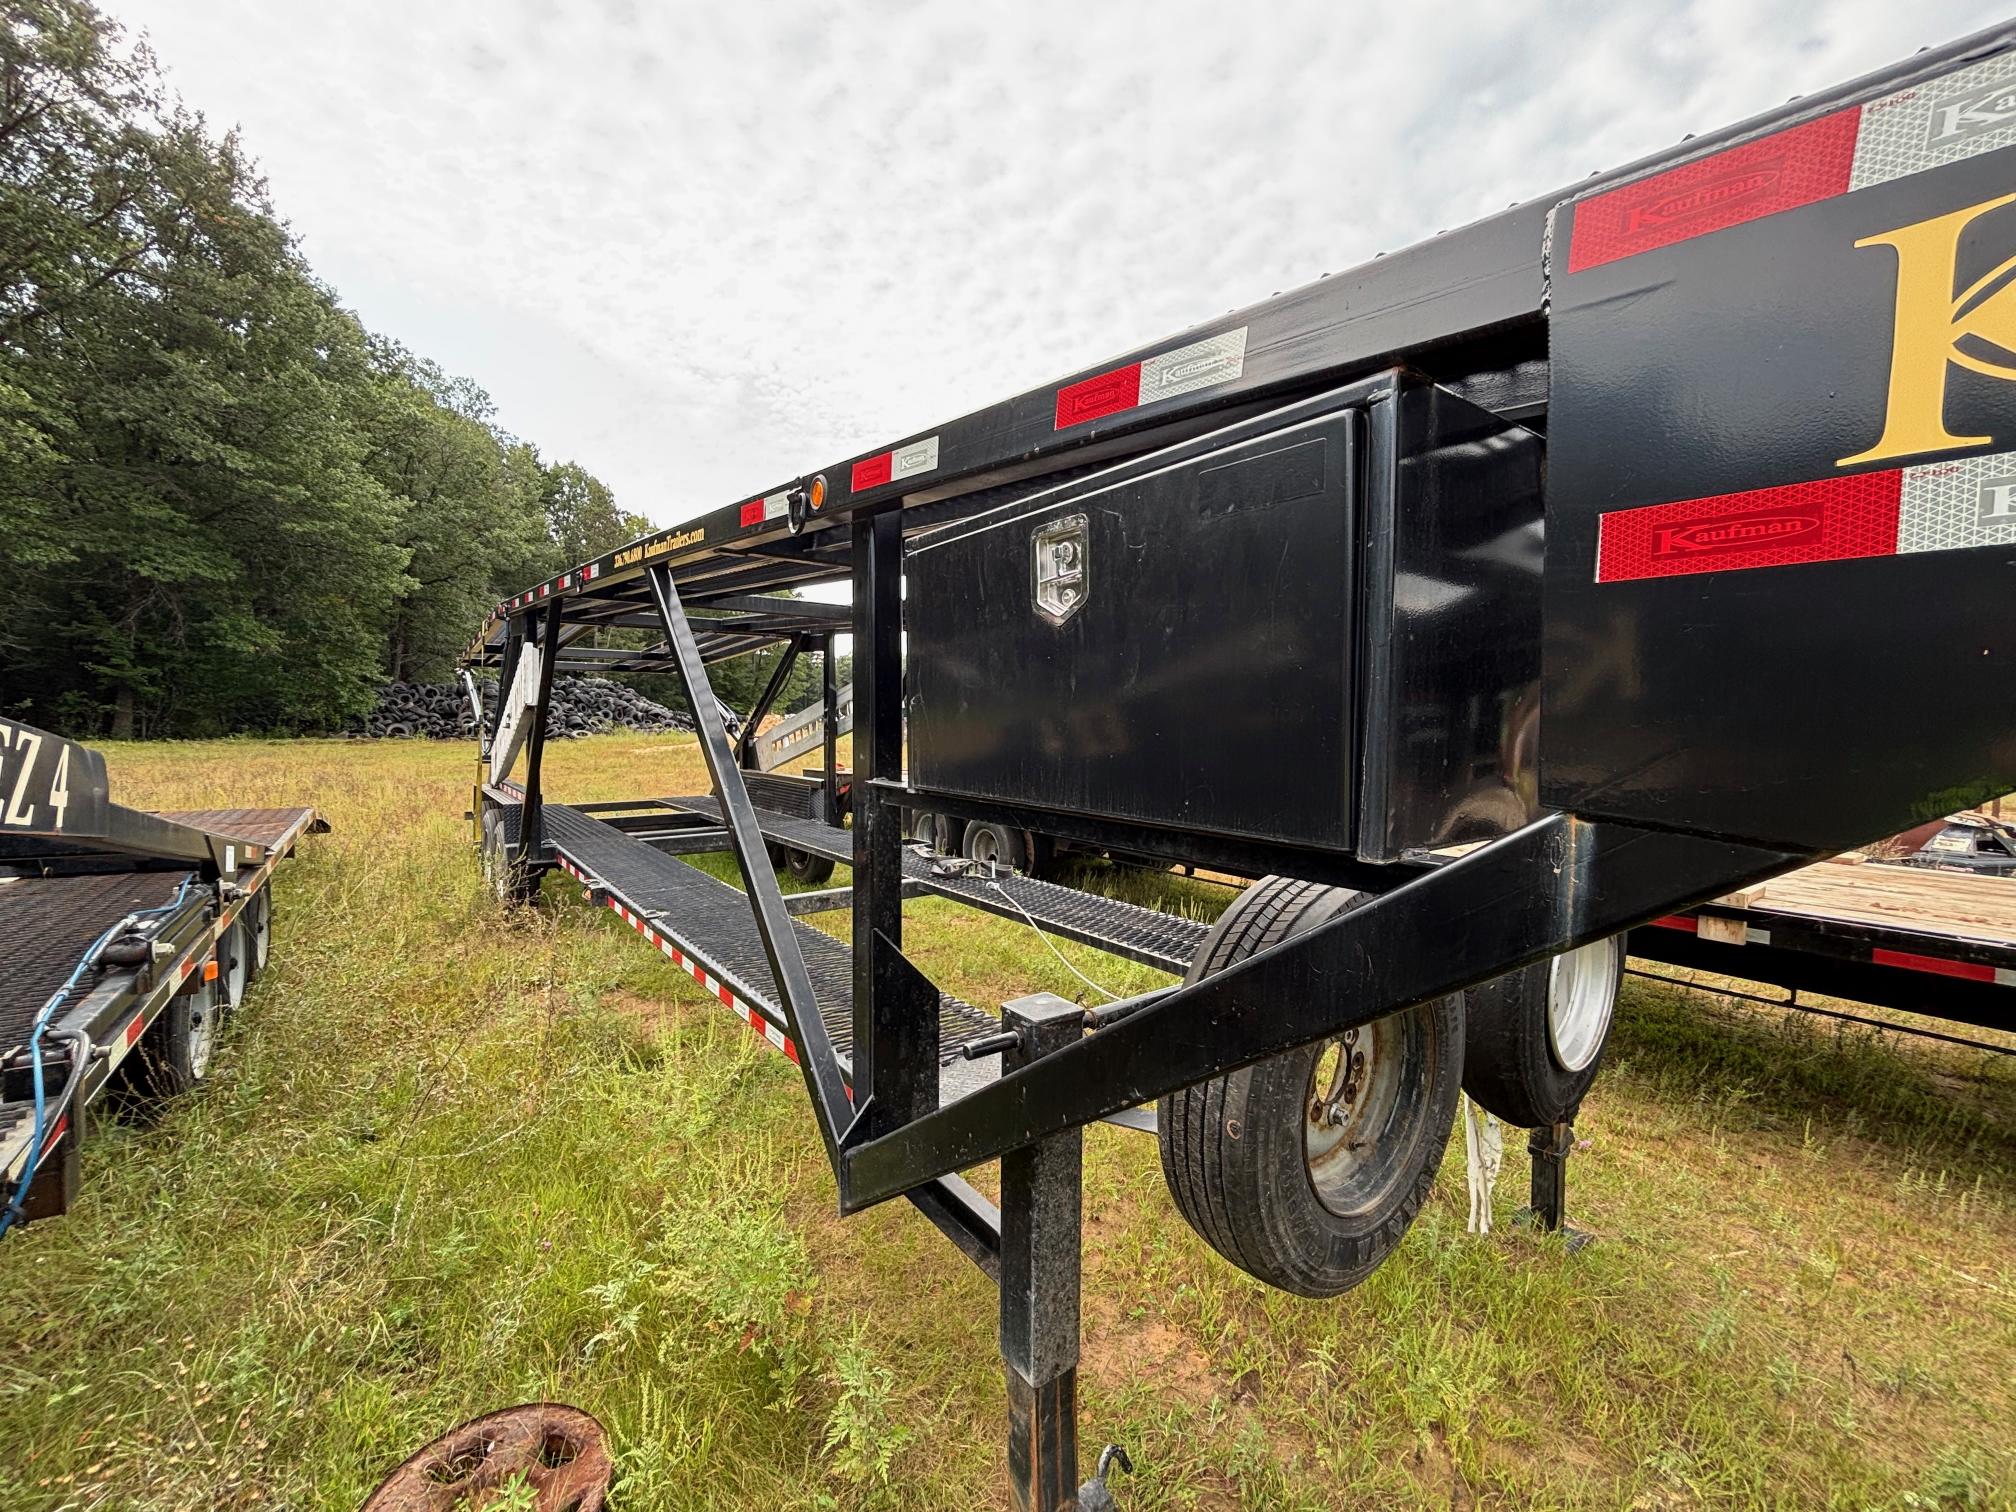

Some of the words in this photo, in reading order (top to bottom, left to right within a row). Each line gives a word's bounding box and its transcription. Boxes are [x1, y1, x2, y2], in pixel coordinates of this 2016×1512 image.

[1624, 173, 1765, 235] Kaufman
[1073, 388, 1116, 412] Kaufman
[1652, 516, 1803, 556] Kaufman
